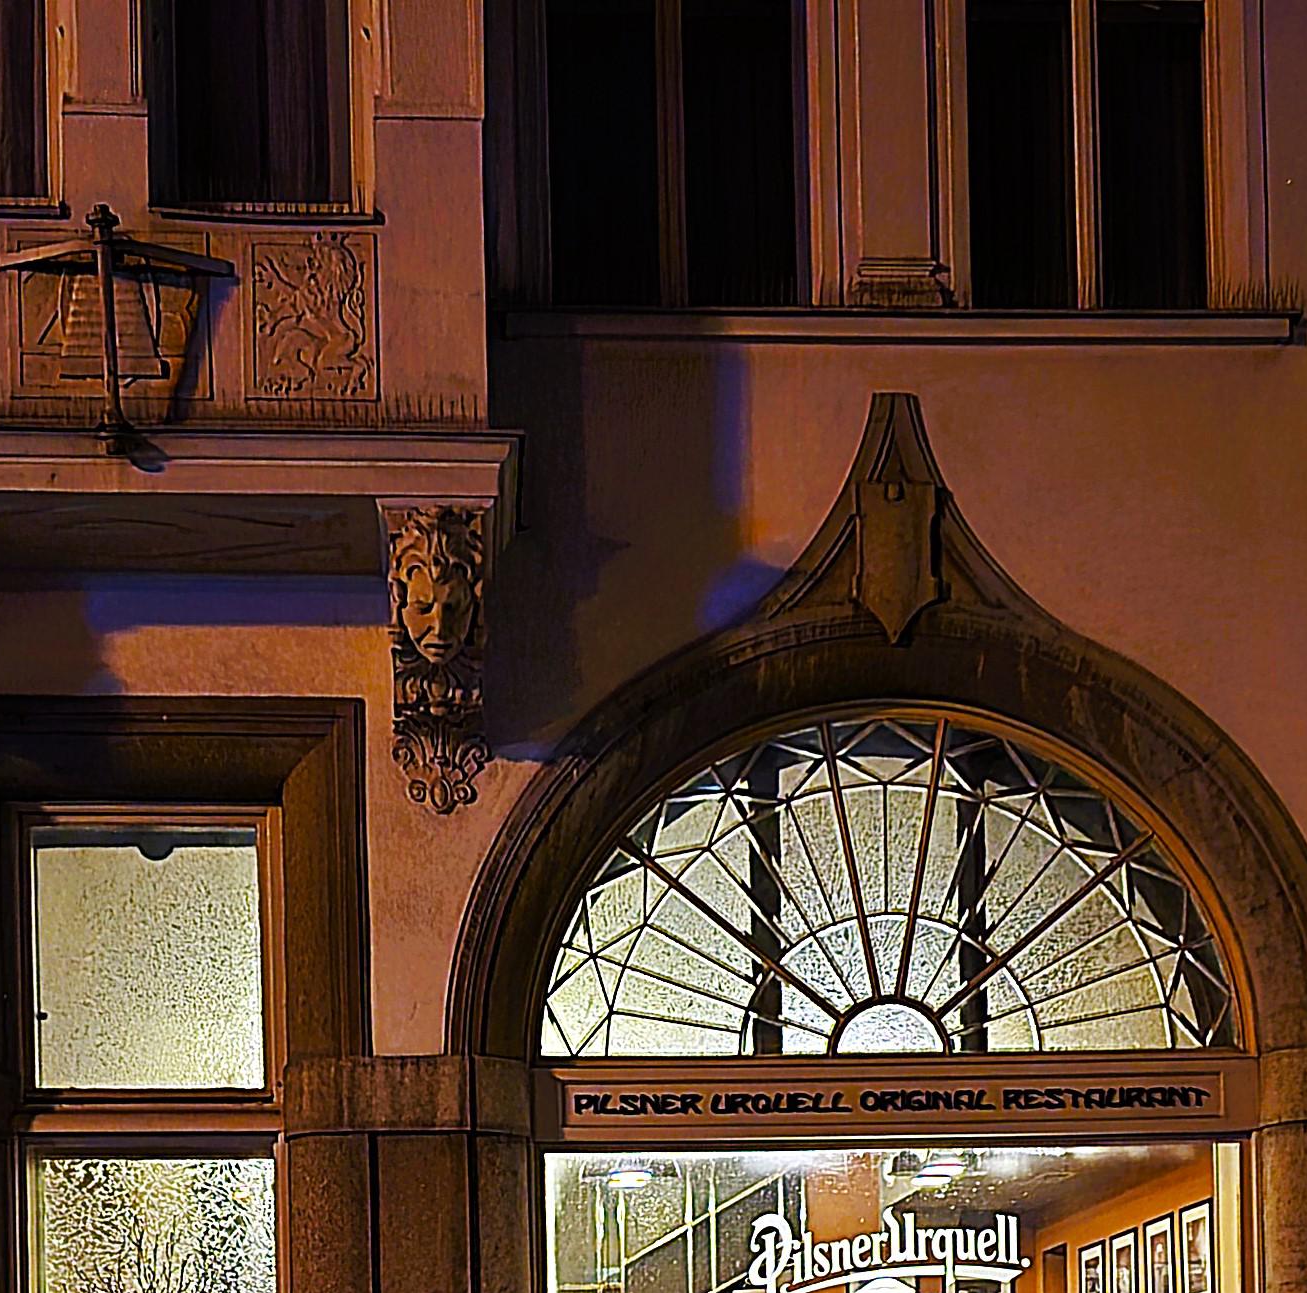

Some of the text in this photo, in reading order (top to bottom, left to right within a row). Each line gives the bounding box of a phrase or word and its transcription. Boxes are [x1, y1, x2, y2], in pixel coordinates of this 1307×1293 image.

[573, 1086, 1212, 1115] PILSNER URQUELL ORIGINAL RESTAURANT
